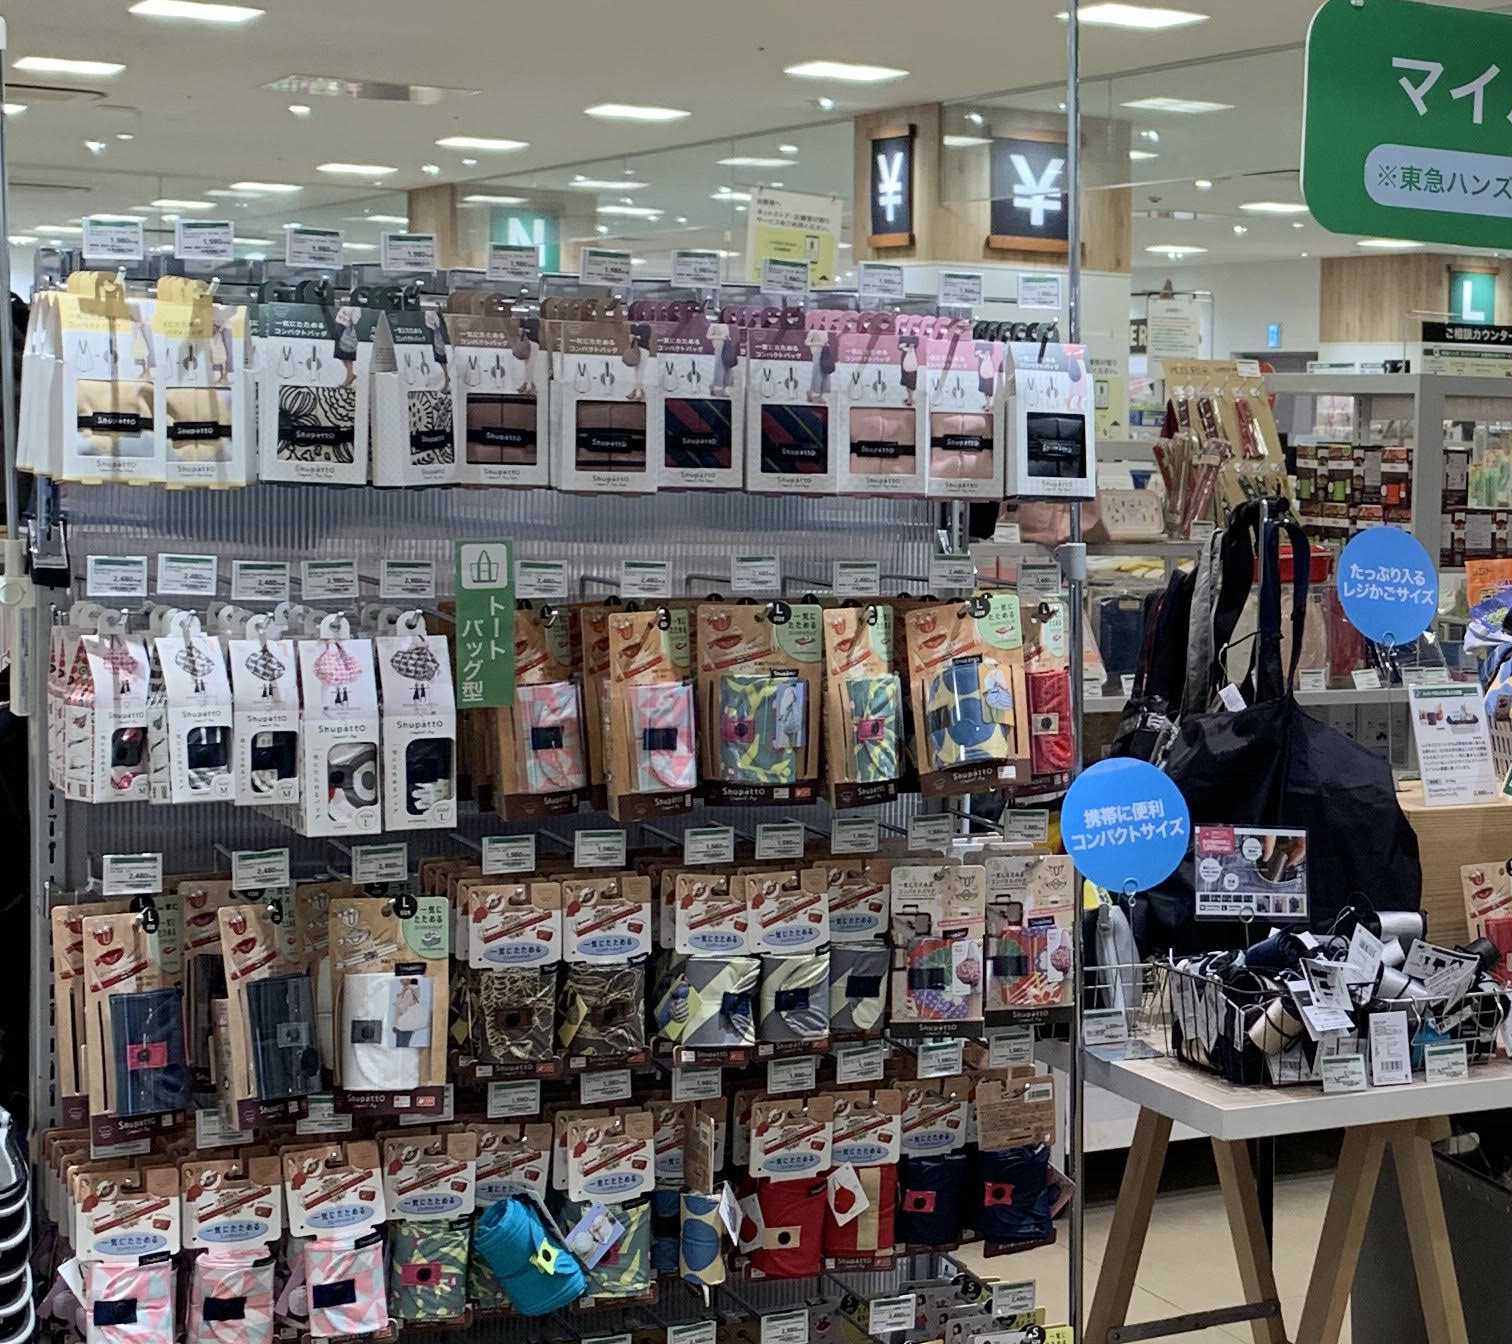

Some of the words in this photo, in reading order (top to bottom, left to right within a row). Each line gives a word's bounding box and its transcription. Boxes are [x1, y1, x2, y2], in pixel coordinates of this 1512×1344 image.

[1462, 280, 1485, 321] L
[1350, 563, 1426, 586] たっぷり入る
[1343, 583, 1435, 605] レジかごサイズ
[490, 595, 505, 660] トート
[461, 619, 484, 702] バッグ型
[1084, 799, 1165, 829] 携帯に便利
[1071, 817, 1184, 852] コンパクトサイズ
